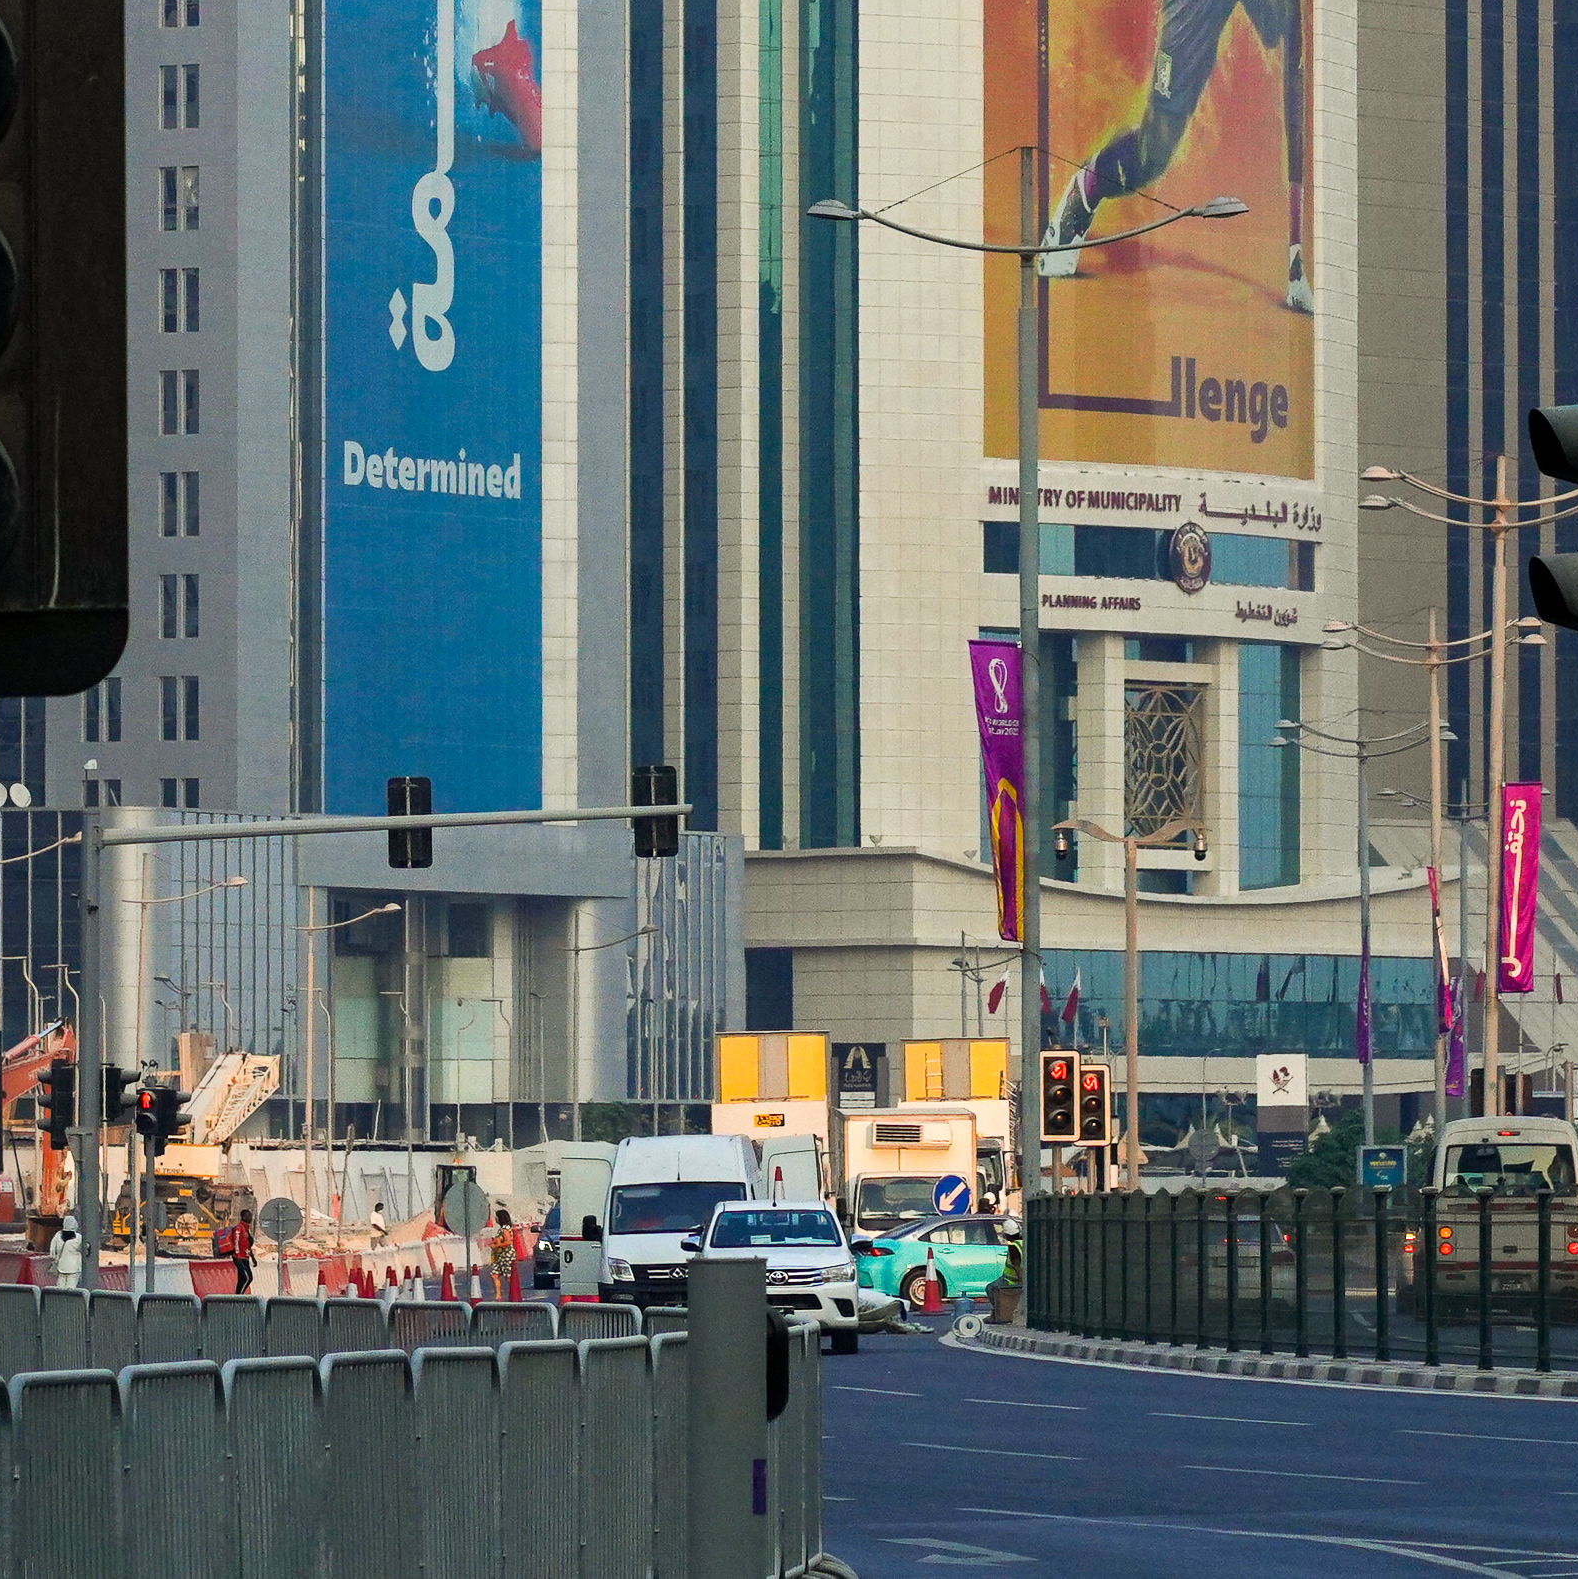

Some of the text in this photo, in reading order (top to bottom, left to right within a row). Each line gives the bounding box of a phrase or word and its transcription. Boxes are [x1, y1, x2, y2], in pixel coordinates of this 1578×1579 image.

[343, 439, 522, 500] Determined
[988, 485, 1182, 514] MINTRY OF MUNICIPALITY
[1041, 594, 1141, 611] PLANNING AFFAIRS
